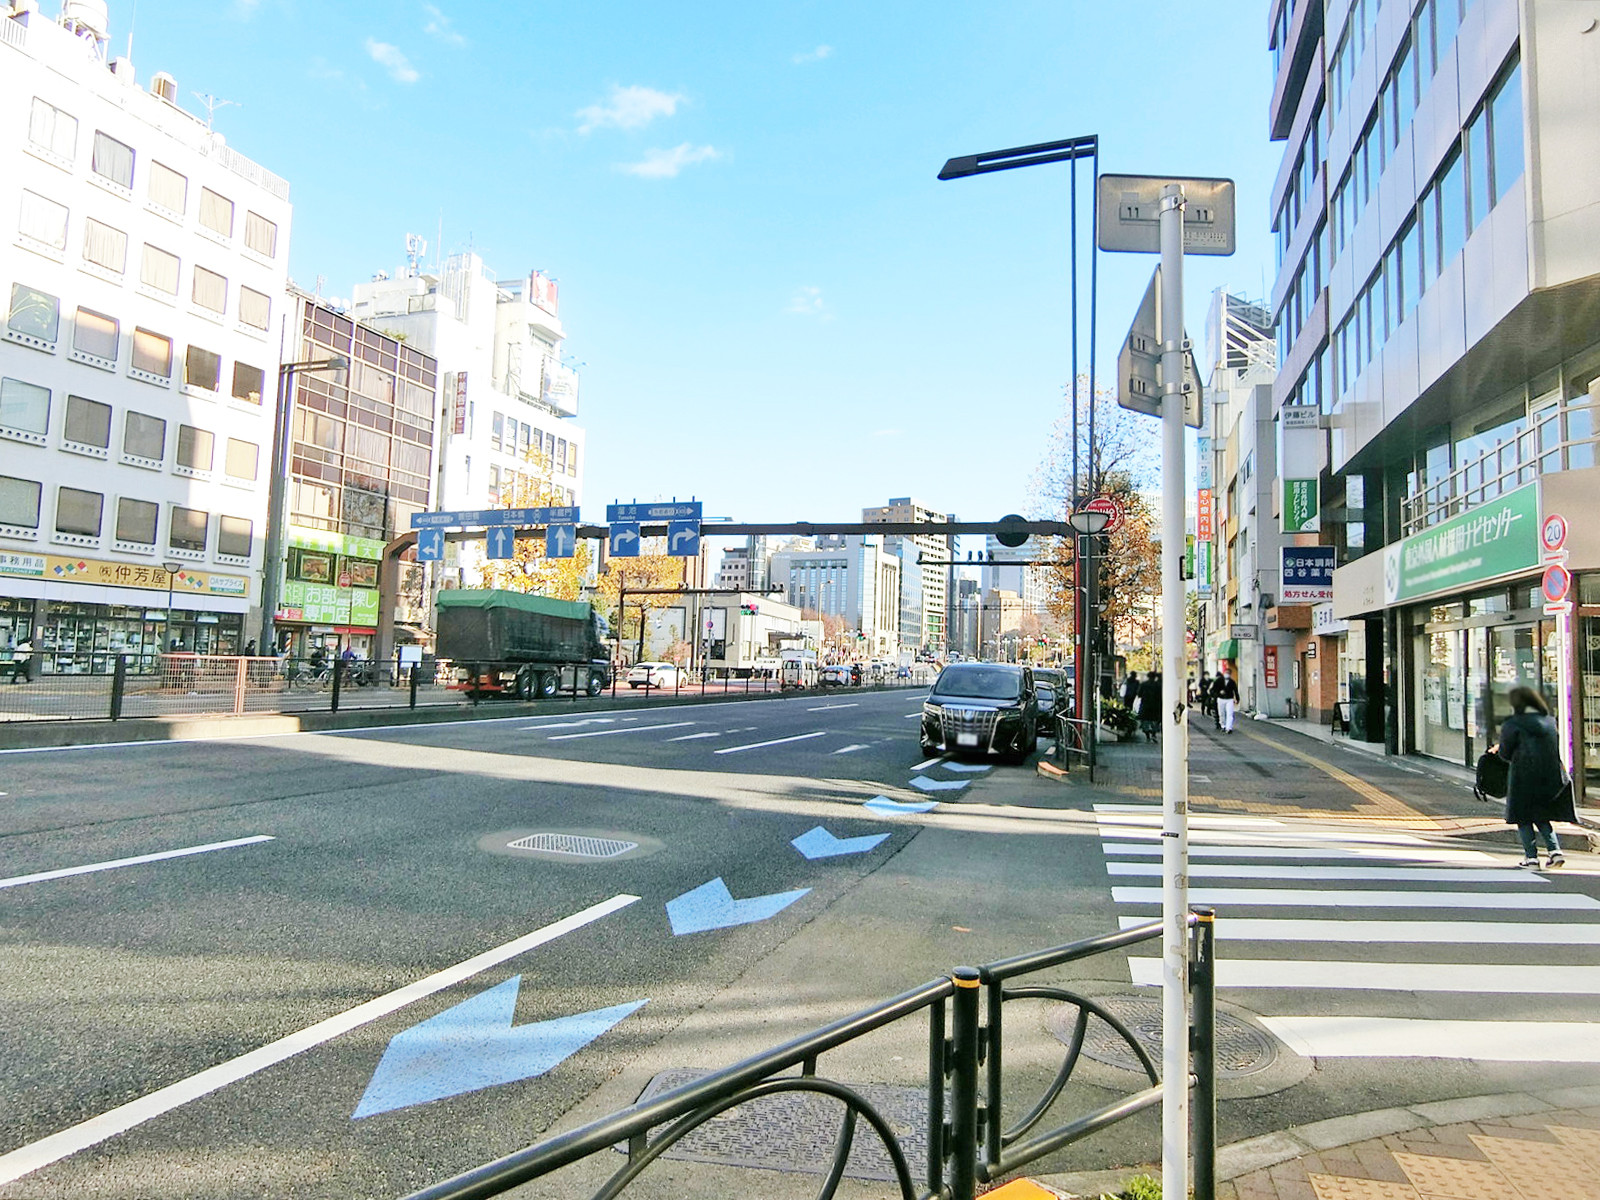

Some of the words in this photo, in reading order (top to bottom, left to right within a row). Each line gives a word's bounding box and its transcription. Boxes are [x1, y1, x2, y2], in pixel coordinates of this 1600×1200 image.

[1127, 207, 1139, 218] 11
[1196, 209, 1208, 221] 11
[502, 510, 526, 519] 日本橋
[1546, 525, 1562, 543] 20
[1296, 558, 1334, 567] 日本調剤
[1284, 590, 1333, 598] 処方せん受付
[304, 604, 350, 623] 専門店
